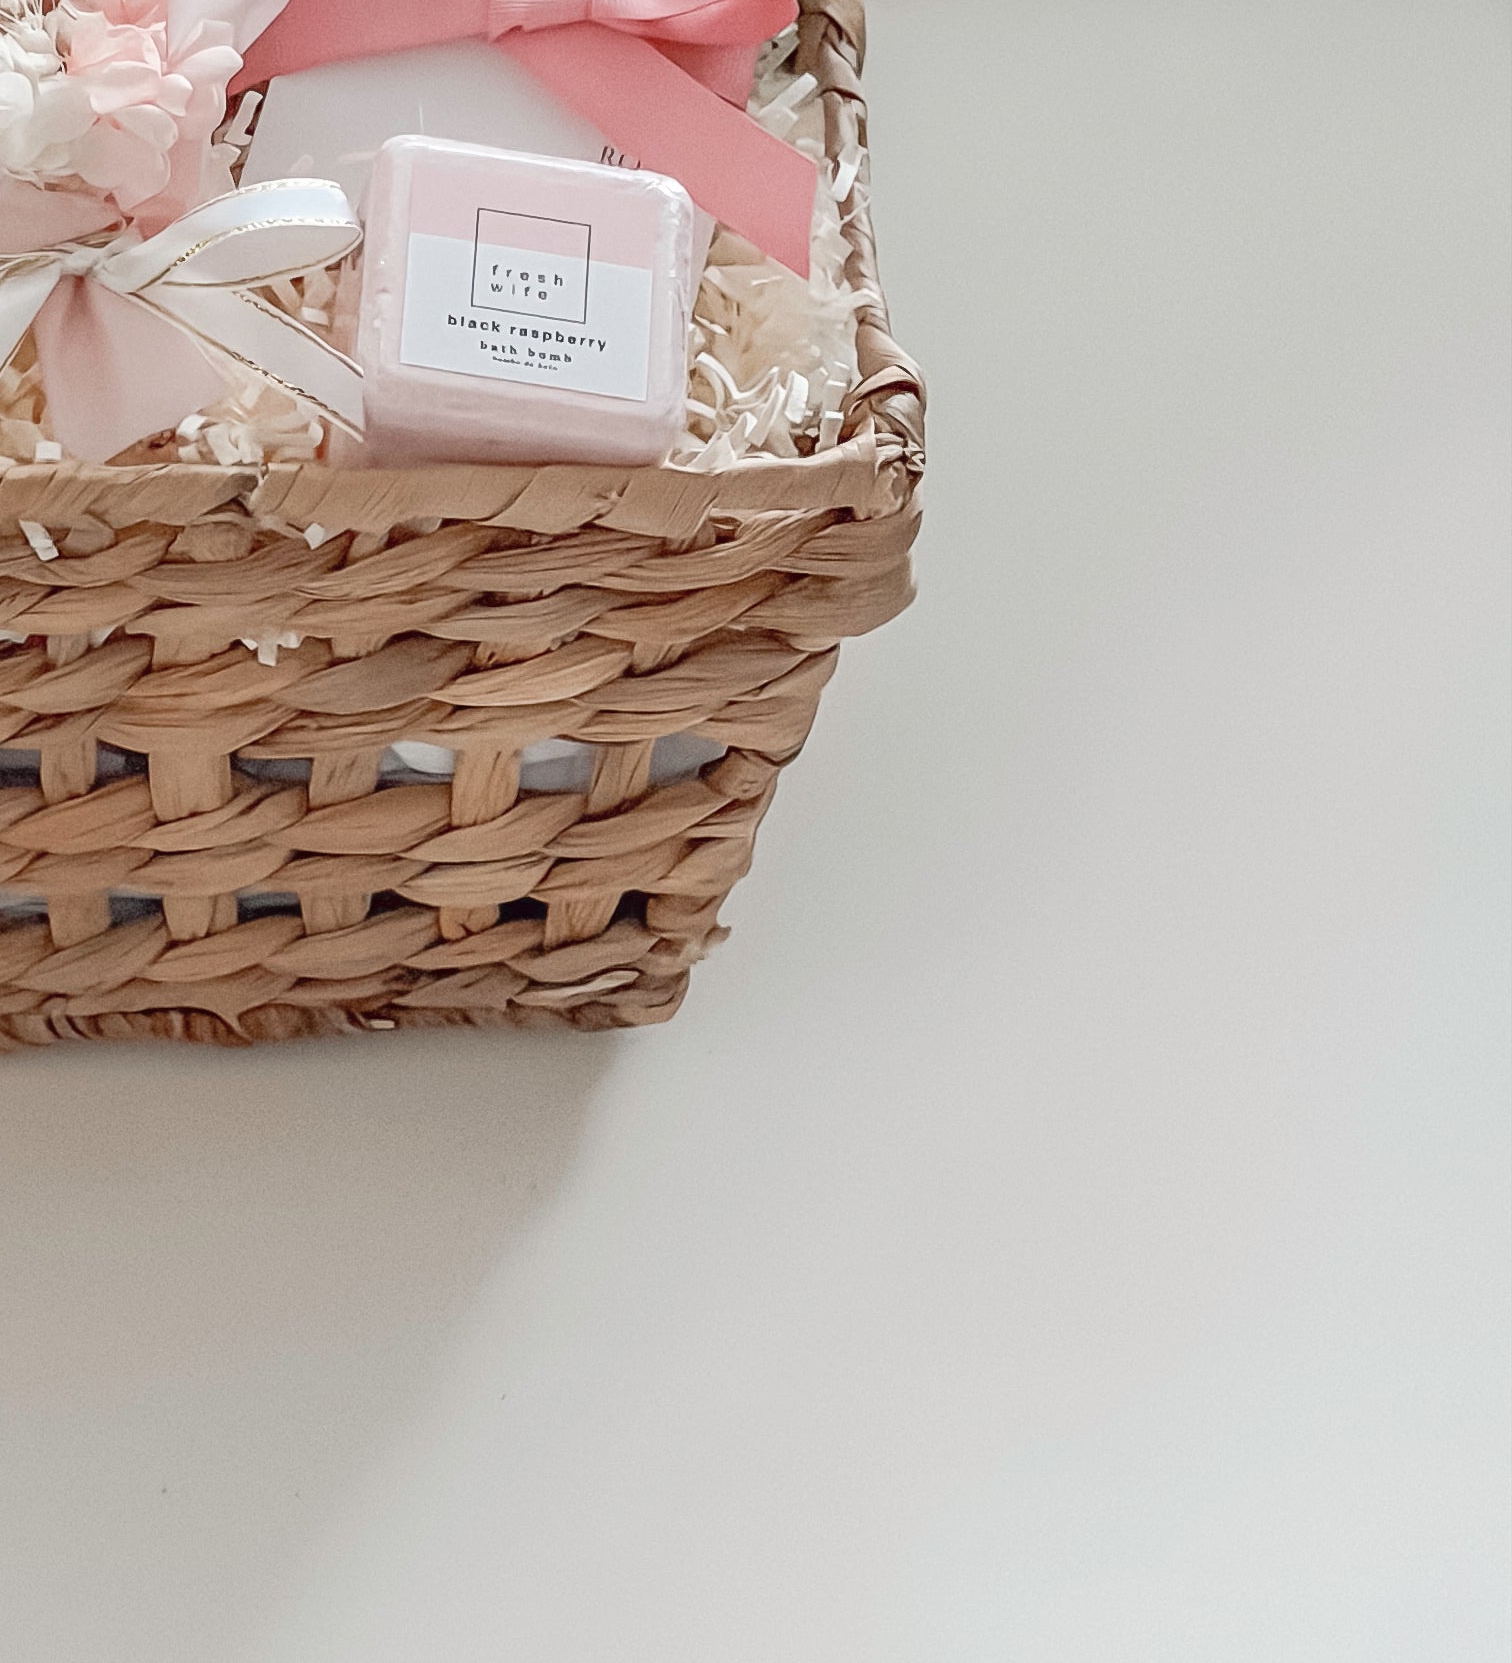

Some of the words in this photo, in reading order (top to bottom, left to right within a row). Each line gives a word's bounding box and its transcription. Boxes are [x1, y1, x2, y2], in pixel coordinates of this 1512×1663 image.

[492, 264, 563, 287] fresh
[490, 283, 548, 301] wife
[447, 314, 501, 333] black
[510, 325, 607, 352] raspberry
[480, 340, 518, 355] bath
[527, 347, 573, 363] bomb
